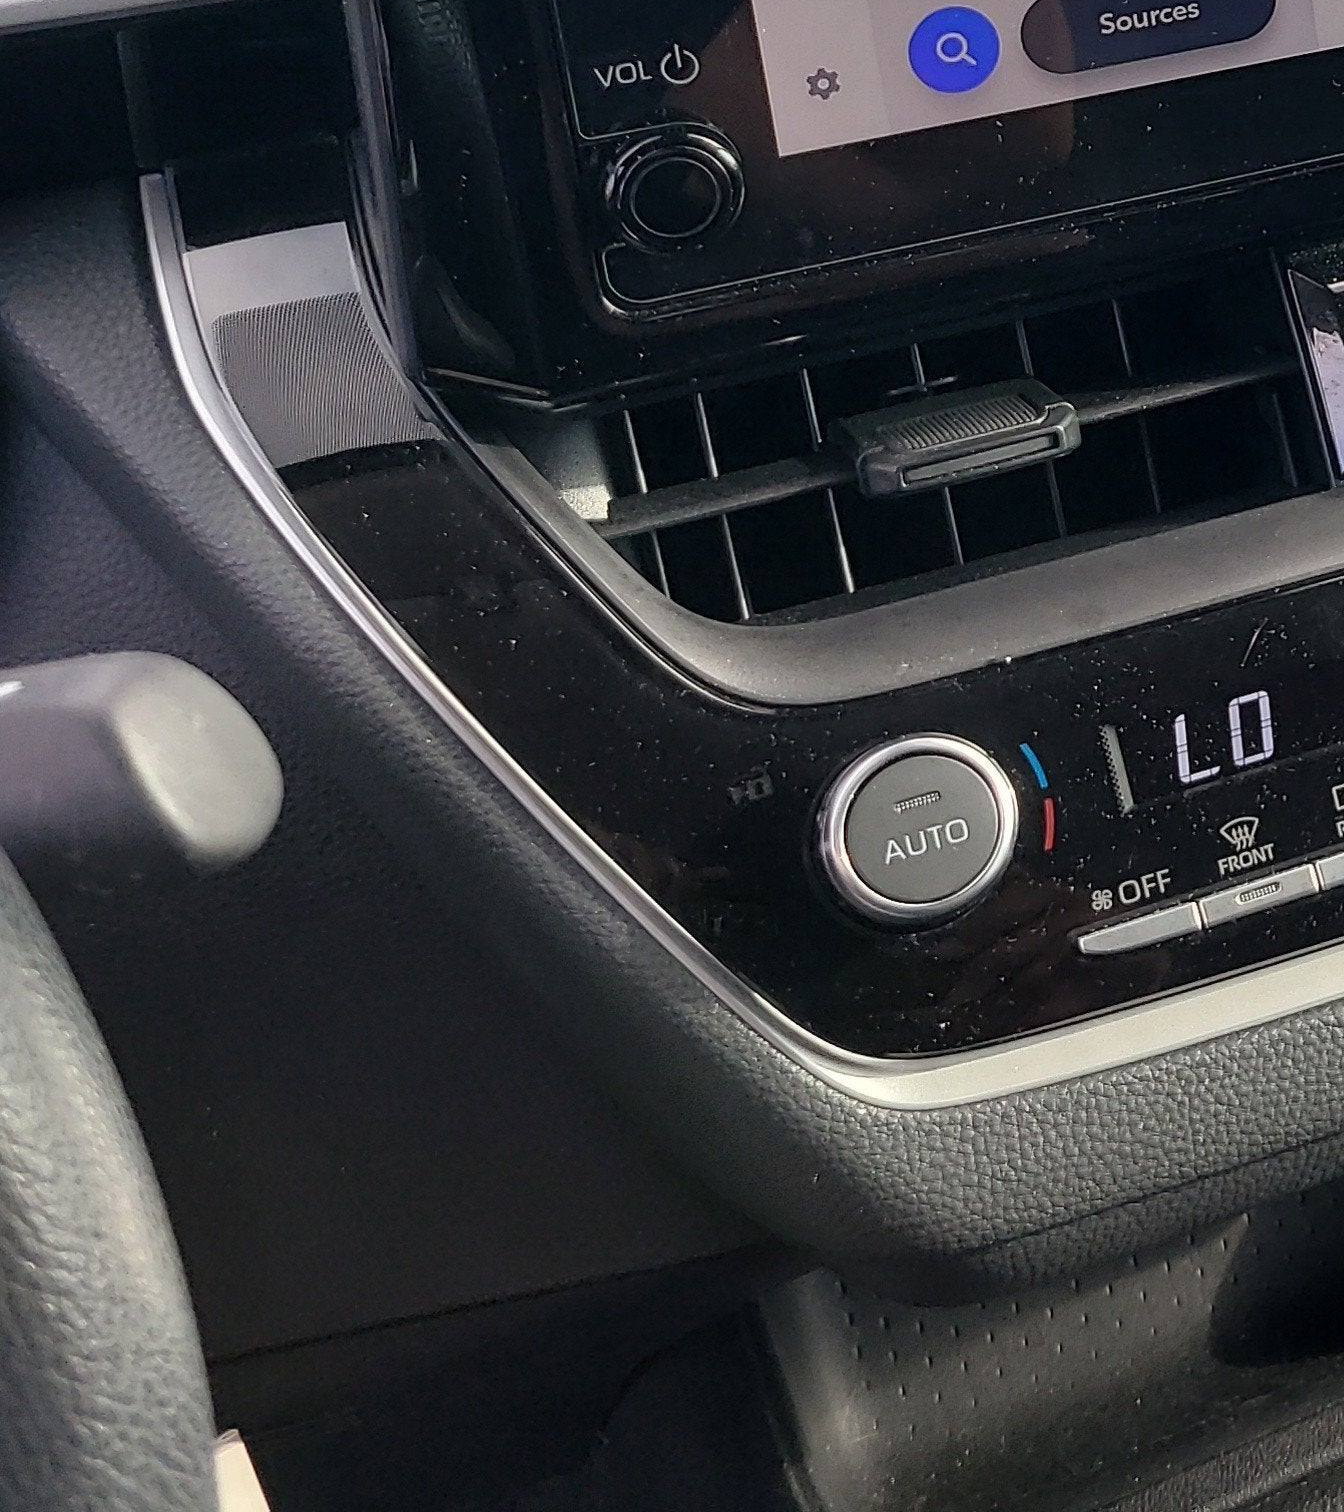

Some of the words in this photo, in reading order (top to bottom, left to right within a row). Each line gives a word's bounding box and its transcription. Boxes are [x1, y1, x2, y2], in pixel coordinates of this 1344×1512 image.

[1099, 0, 1201, 36] Sources
[593, 60, 653, 88] VOL
[883, 817, 971, 866] AUTO
[1216, 842, 1275, 876] FRONT
[1118, 868, 1173, 904] OFF
